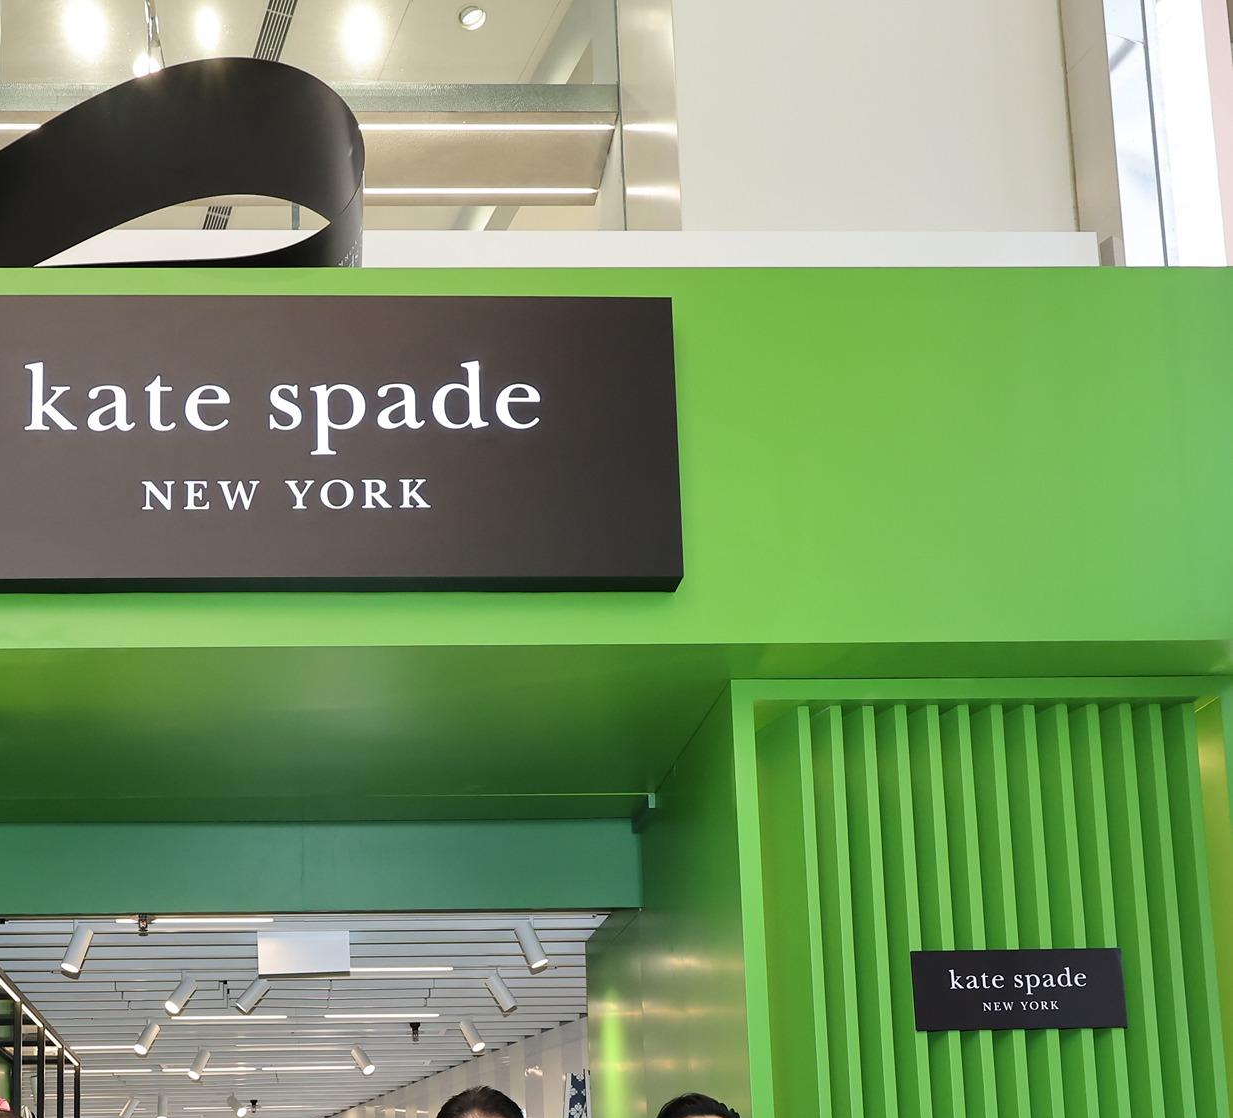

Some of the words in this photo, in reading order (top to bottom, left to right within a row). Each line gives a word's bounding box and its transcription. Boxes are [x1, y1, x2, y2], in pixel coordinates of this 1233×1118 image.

[24, 361, 231, 432] kate
[269, 360, 541, 456] spade
[141, 480, 260, 511] NEW
[284, 478, 432, 510] YORK
[948, 969, 1005, 990] kate
[1013, 966, 1087, 996] spade
[982, 1001, 1014, 1012] NEW
[1020, 1000, 1060, 1011] YORK
